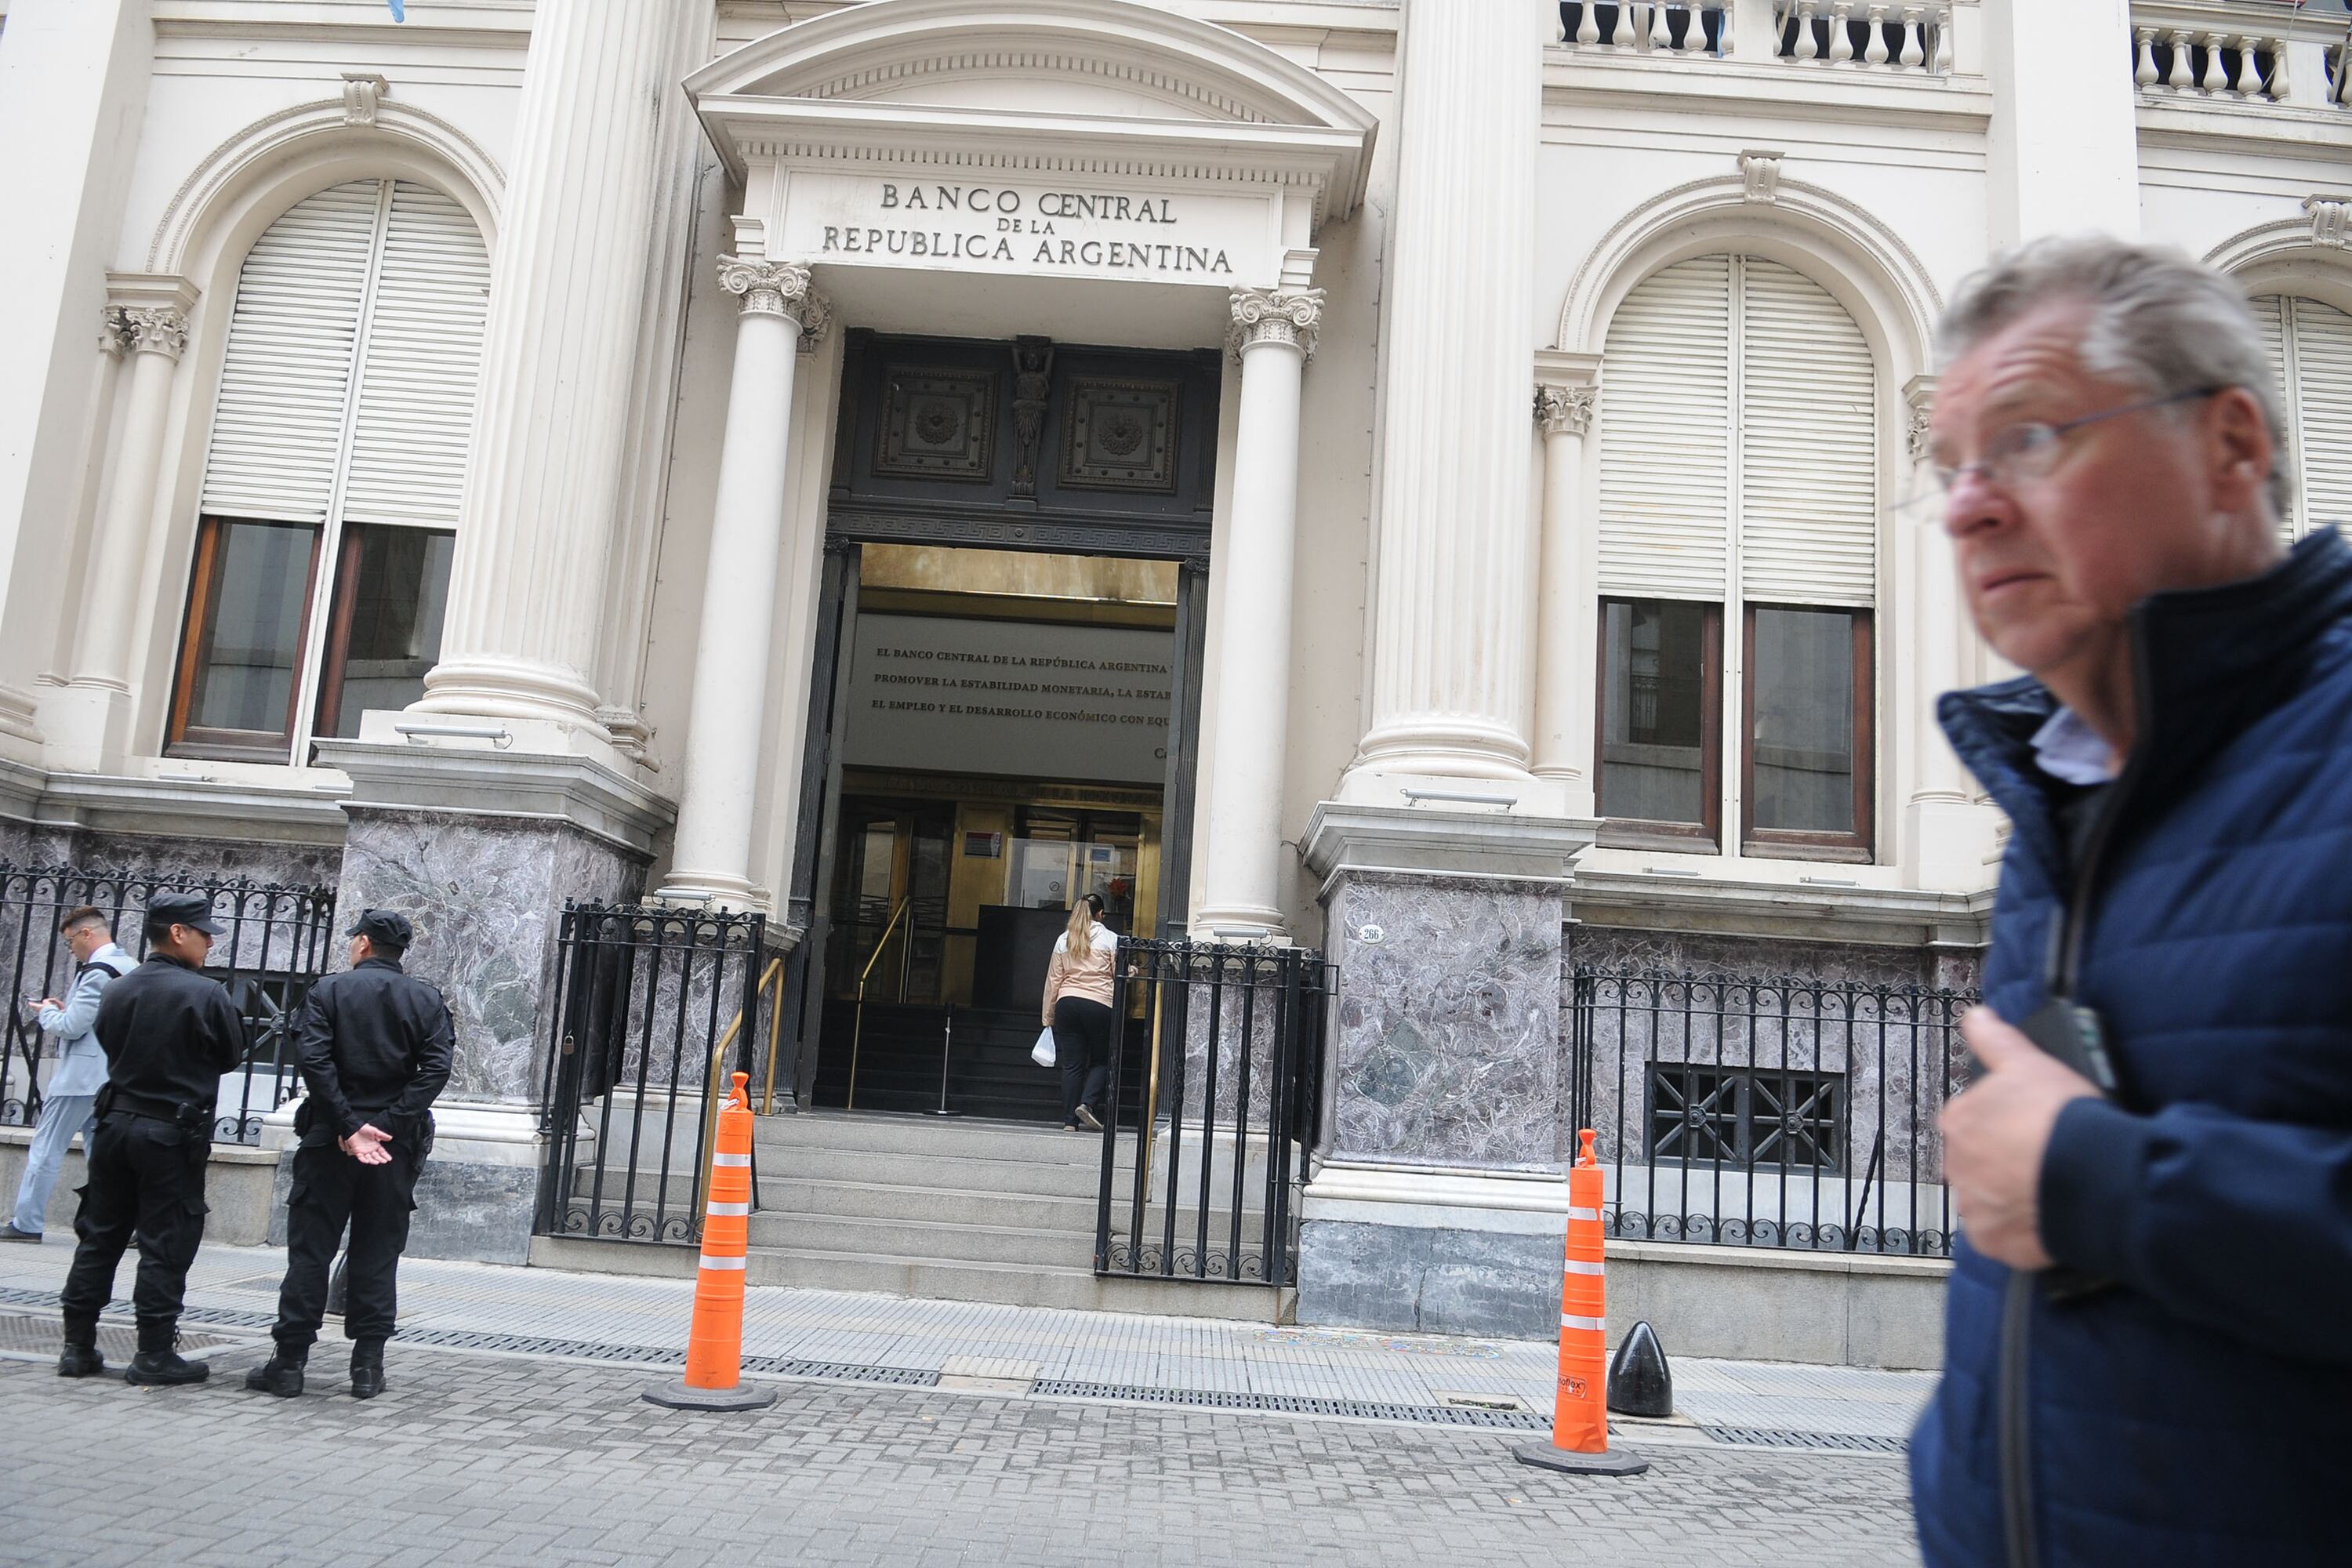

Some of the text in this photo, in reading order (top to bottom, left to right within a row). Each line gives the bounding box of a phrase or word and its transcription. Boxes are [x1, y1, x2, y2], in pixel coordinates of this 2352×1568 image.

[880, 184, 1178, 224] BANCO CENTRAL
[996, 217, 1055, 235] DE LA
[822, 226, 1233, 273] REPUBLICA ARGENTINA
[877, 648, 1167, 674] EL BANCO CENTRAL DE LA REPÚBLICA ARGENTINA
[874, 673, 939, 686] PROMOVER
[942, 678, 957, 688] LA
[960, 679, 1039, 692] ESTABILIDAD
[1041, 684, 1114, 698] MONETARIA,
[1117, 688, 1133, 698] LA
[872, 699, 886, 709] EL
[889, 701, 935, 712] EMPLEO
[938, 703, 946, 713] Y
[949, 705, 964, 714] EL
[967, 706, 1043, 719] DESARROLLO
[1046, 710, 1117, 723] ECONÓMICO
[1120, 715, 1144, 724] CON
[1364, 928, 1379, 939] 266
